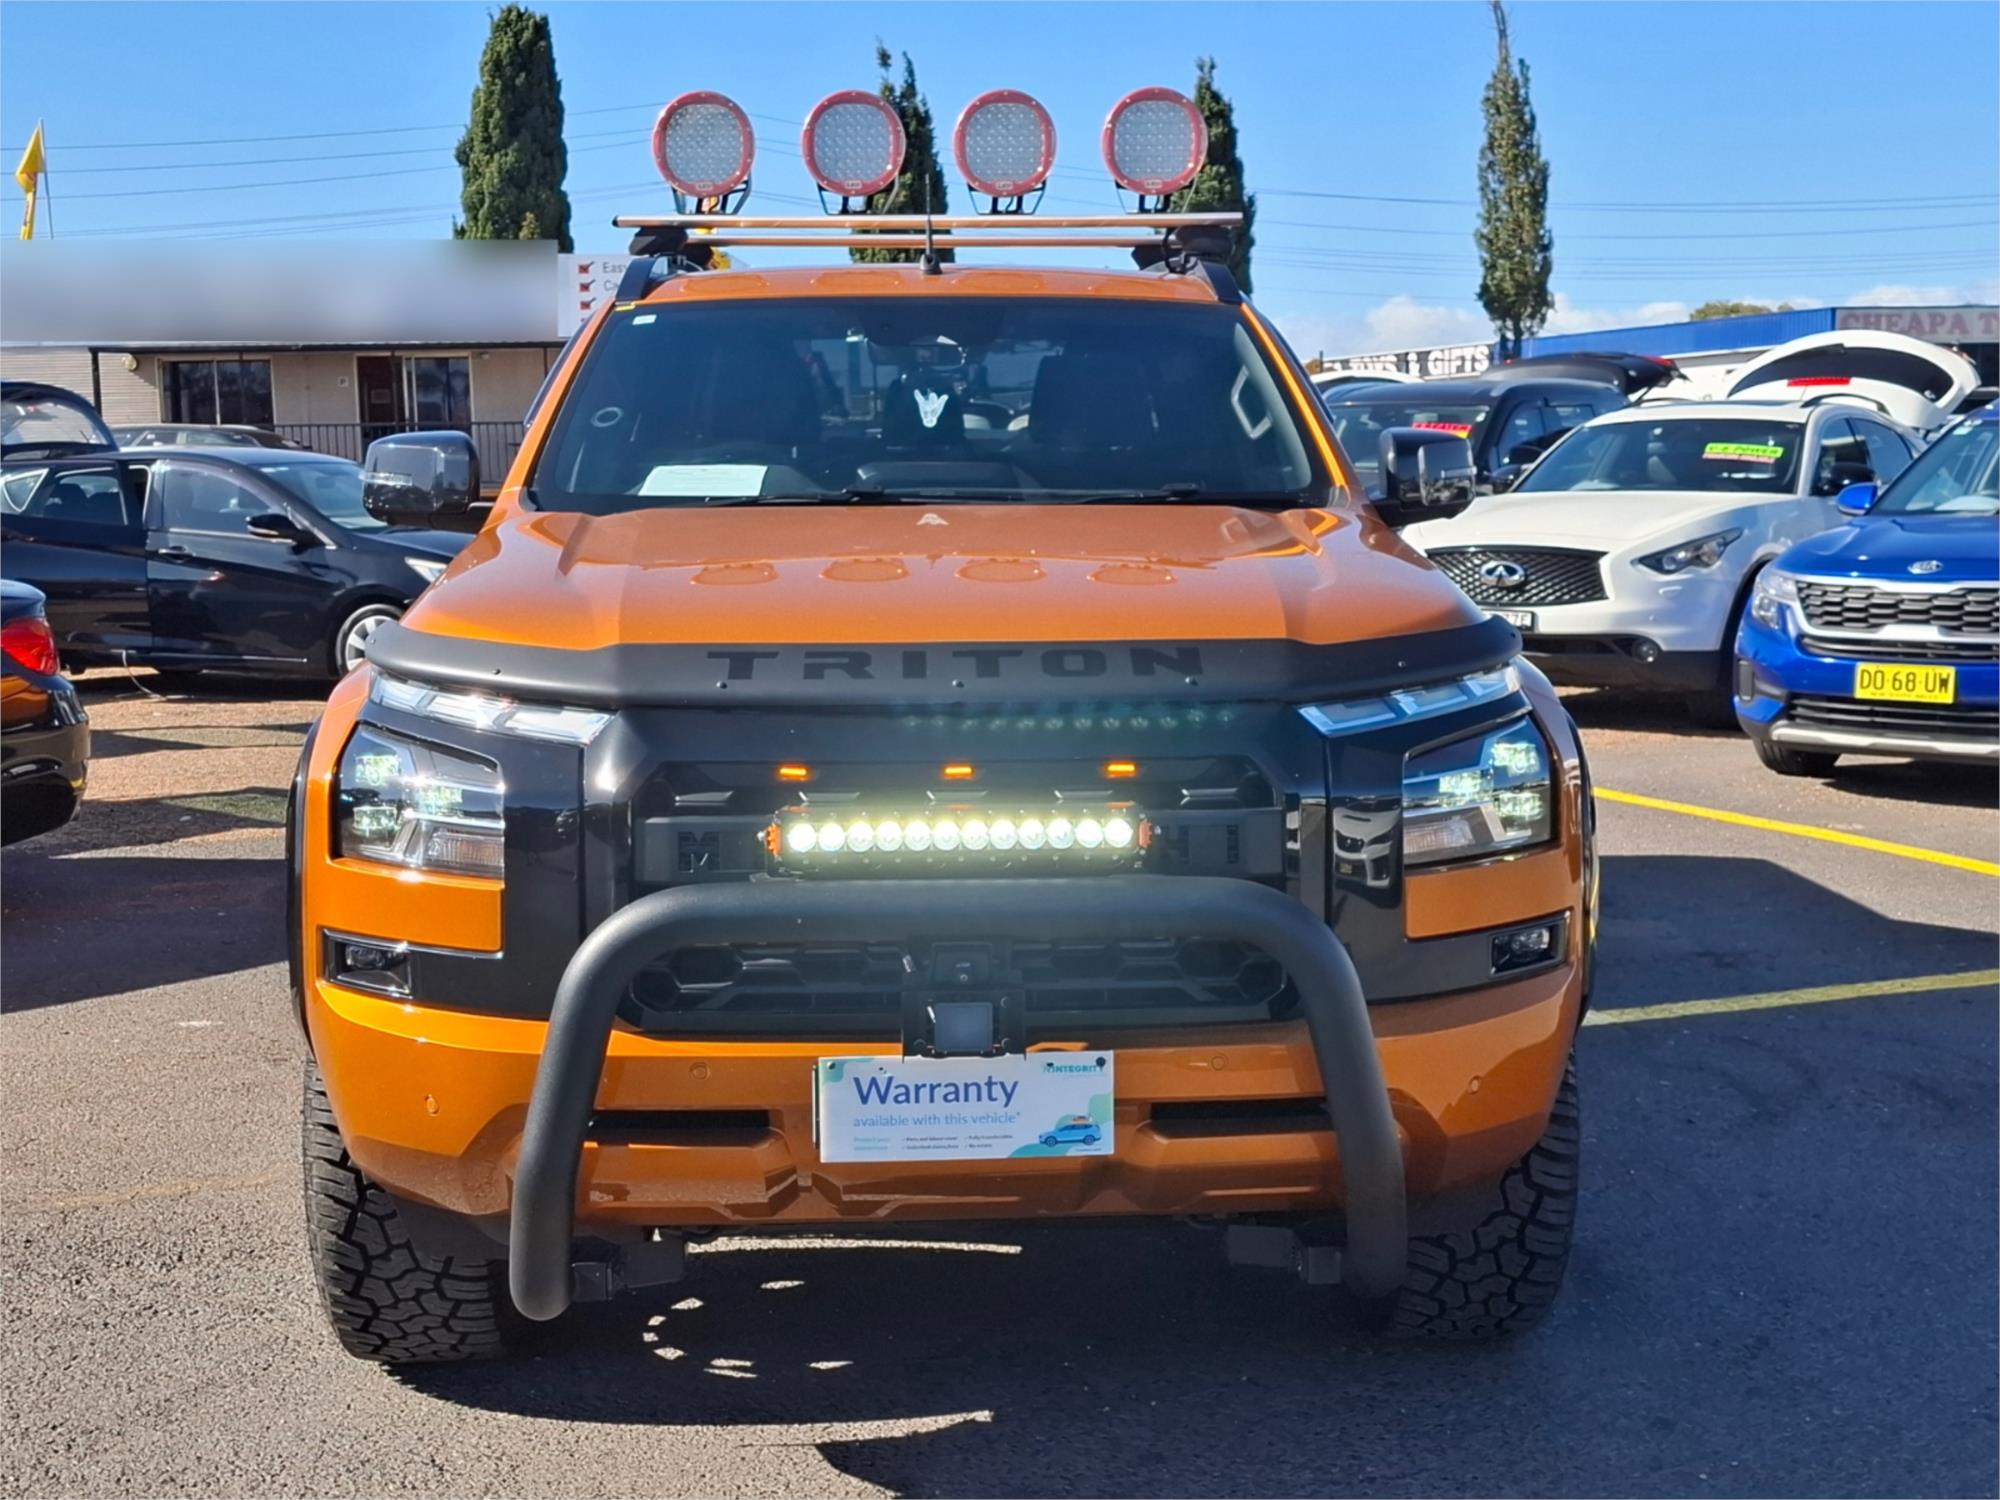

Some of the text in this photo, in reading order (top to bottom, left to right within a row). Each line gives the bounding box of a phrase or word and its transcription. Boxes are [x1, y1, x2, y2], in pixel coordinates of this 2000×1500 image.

[1427, 344, 1490, 377] GIFTS
[706, 645, 1204, 681] TRITON
[1892, 670, 1917, 693] 68
[853, 1075, 1020, 1108] Warranty
[853, 1115, 909, 1128] available
[912, 1113, 941, 1127] with
[944, 1112, 969, 1126] this
